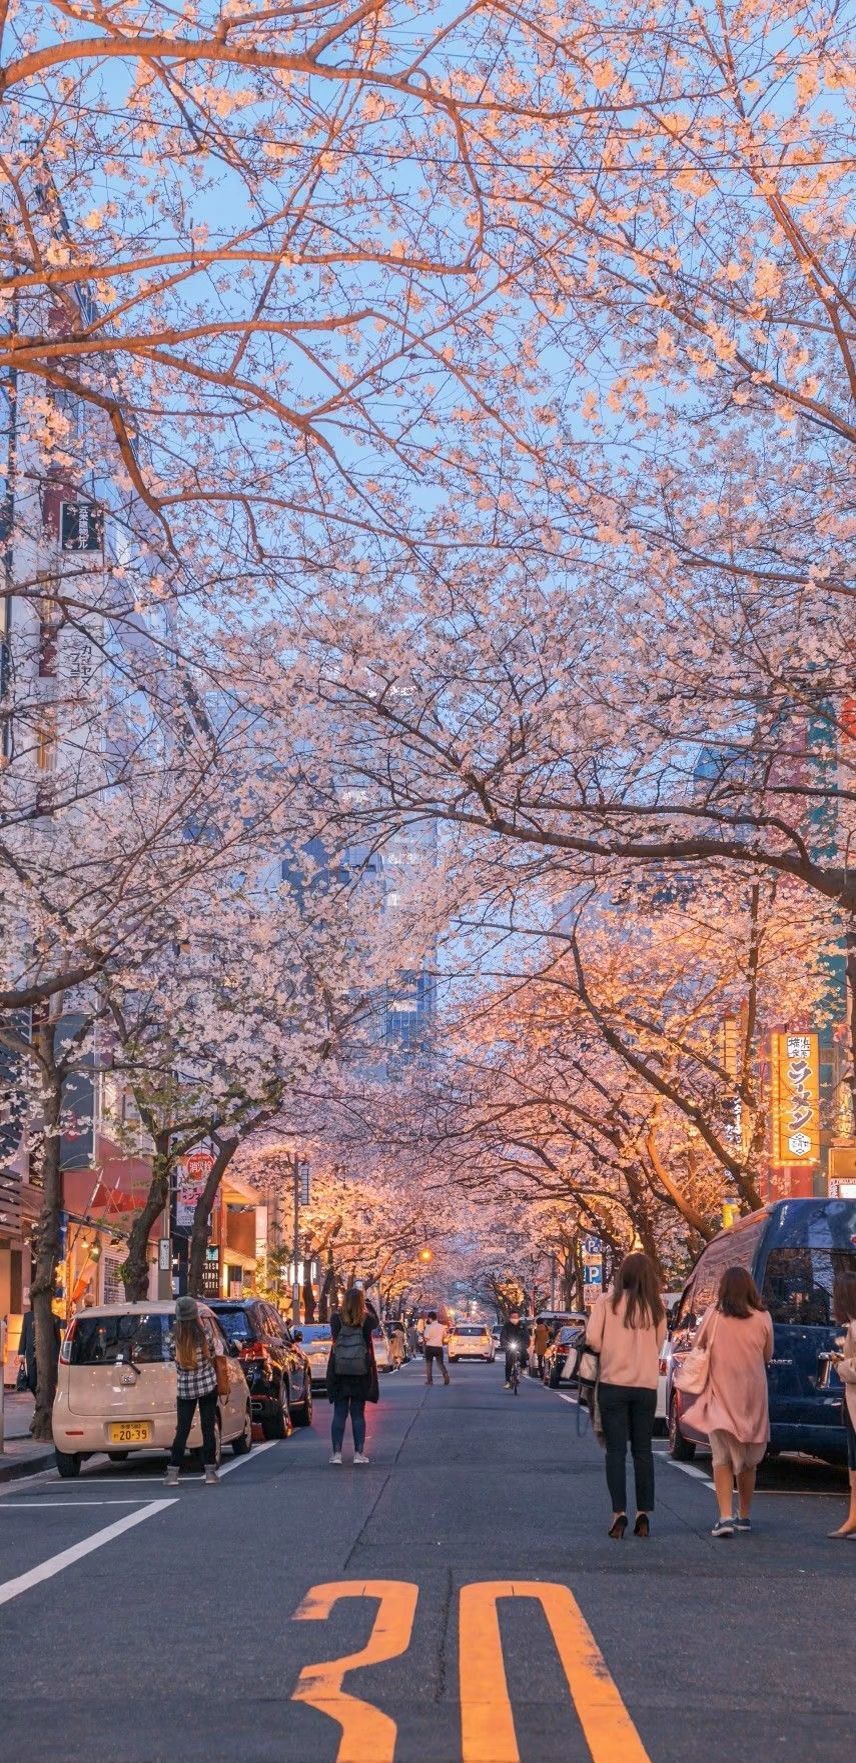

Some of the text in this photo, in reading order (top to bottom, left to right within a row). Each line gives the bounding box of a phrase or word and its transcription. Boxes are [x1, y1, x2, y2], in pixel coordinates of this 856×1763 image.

[789, 1060, 812, 1131] ラーメン
[189, 1161, 212, 1173] 消火栓
[589, 1266, 600, 1283] P
[292, 1579, 652, 1763] 30
